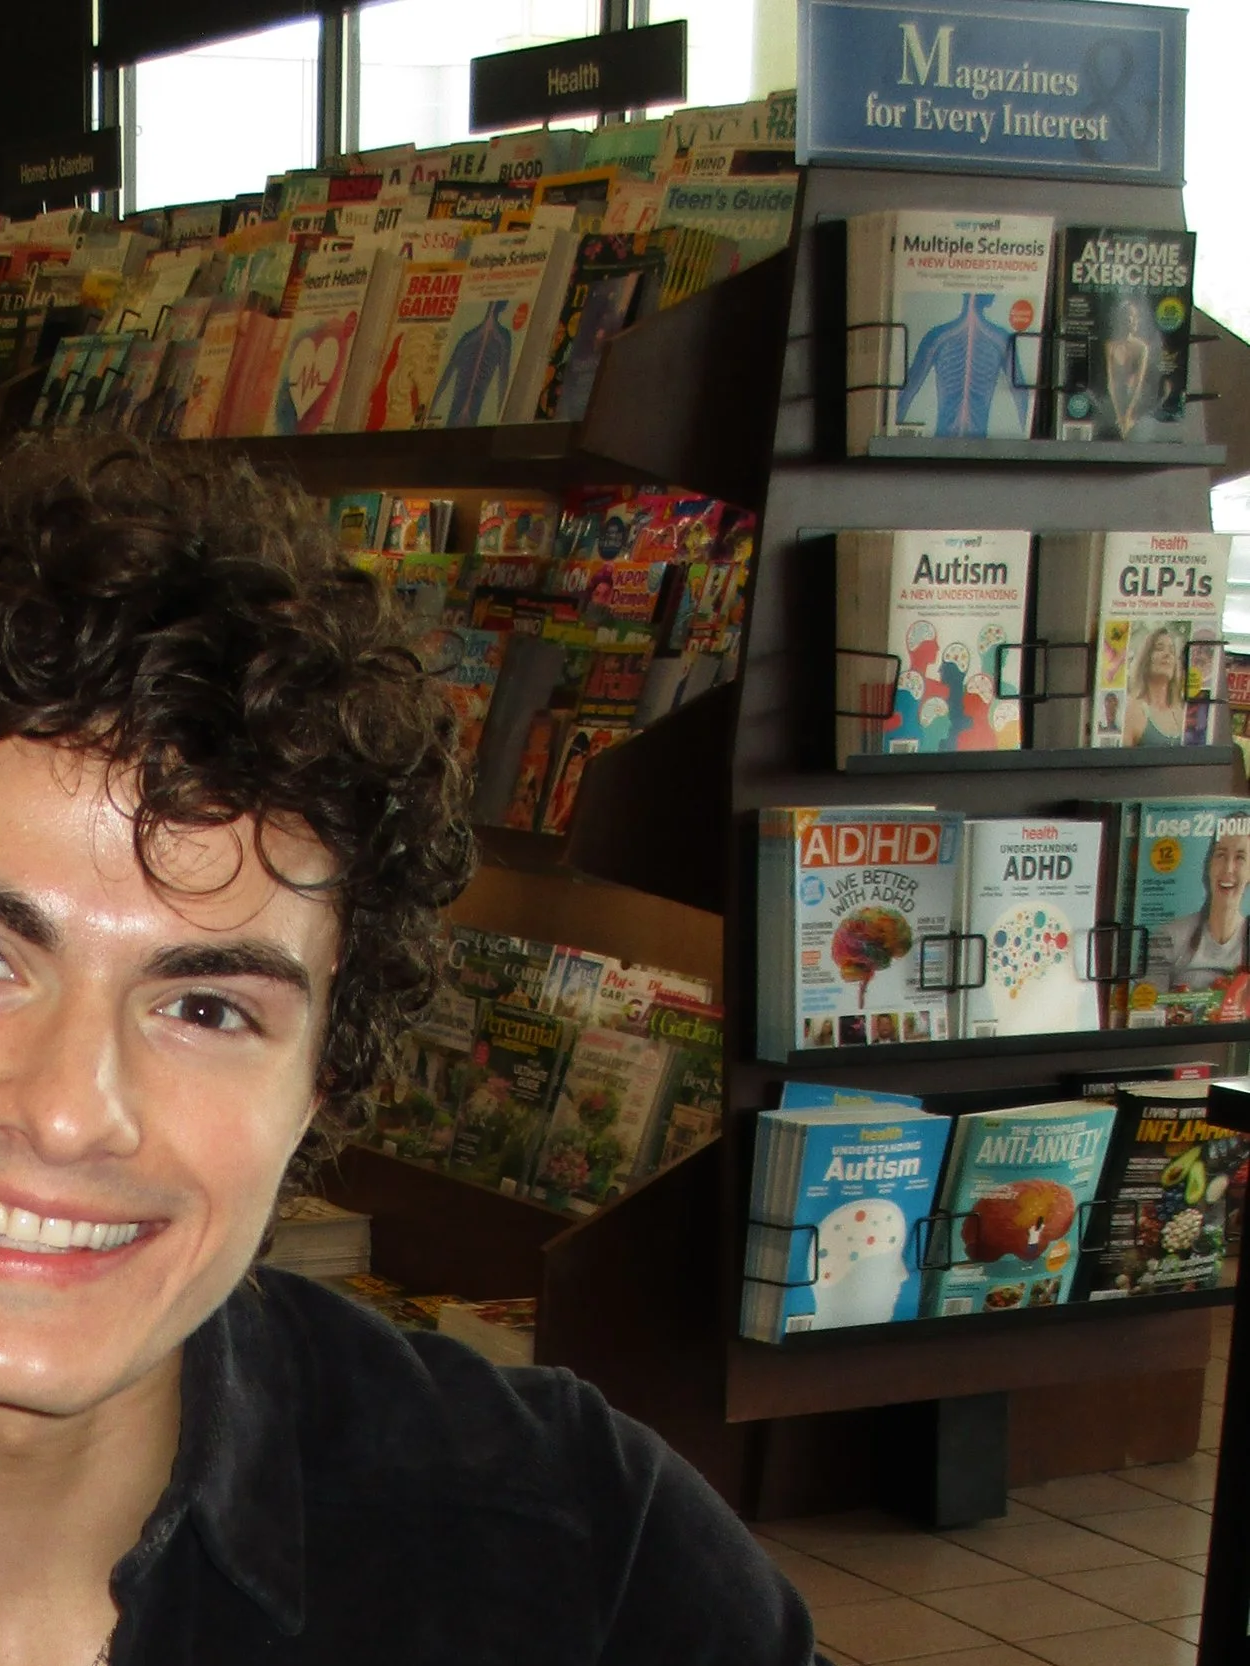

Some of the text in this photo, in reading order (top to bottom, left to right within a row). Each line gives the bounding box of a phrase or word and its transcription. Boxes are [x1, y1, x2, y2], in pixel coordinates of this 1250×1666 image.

[897, 21, 1080, 101] Magazines
[547, 63, 600, 96] Health
[865, 90, 1110, 145] for Every Interest
[19, 155, 94, 185] Home & Garden
[499, 160, 543, 184] BLOOD
[695, 157, 726, 169] MIND
[669, 187, 793, 211] Teen's Guide
[903, 235, 1045, 257] Multiple Sclerosis
[1080, 240, 1182, 265] AT-HOME
[917, 258, 945, 269] NEW
[948, 258, 1039, 271] UNDERSTANDING
[1071, 261, 1188, 288] EXERCISES
[406, 274, 463, 296] BRAIN
[398, 295, 460, 318] GAMES
[1151, 535, 1188, 550] health
[912, 553, 1007, 585] Autism
[1129, 554, 1207, 565] UNDERSTANDING
[1119, 565, 1213, 598] GLP-1s
[910, 590, 934, 600] NEW
[936, 590, 1018, 601] UNDERSTANDING
[1021, 825, 1059, 841] health
[1145, 814, 1191, 838] Lose
[1192, 812, 1216, 837] 22
[802, 825, 939, 866] ADHD
[1000, 844, 1078, 855] UNDERSTANDING
[1159, 846, 1174, 860] 12
[1002, 855, 1073, 881] ADHD
[828, 869, 919, 899] LIVE BETTER
[830, 885, 915, 917] WITH ADHD
[832, 1141, 922, 1156] UNDERSTANDING
[974, 1127, 1104, 1165] ANTI-ANXIETY
[823, 1155, 921, 1182] Autism
